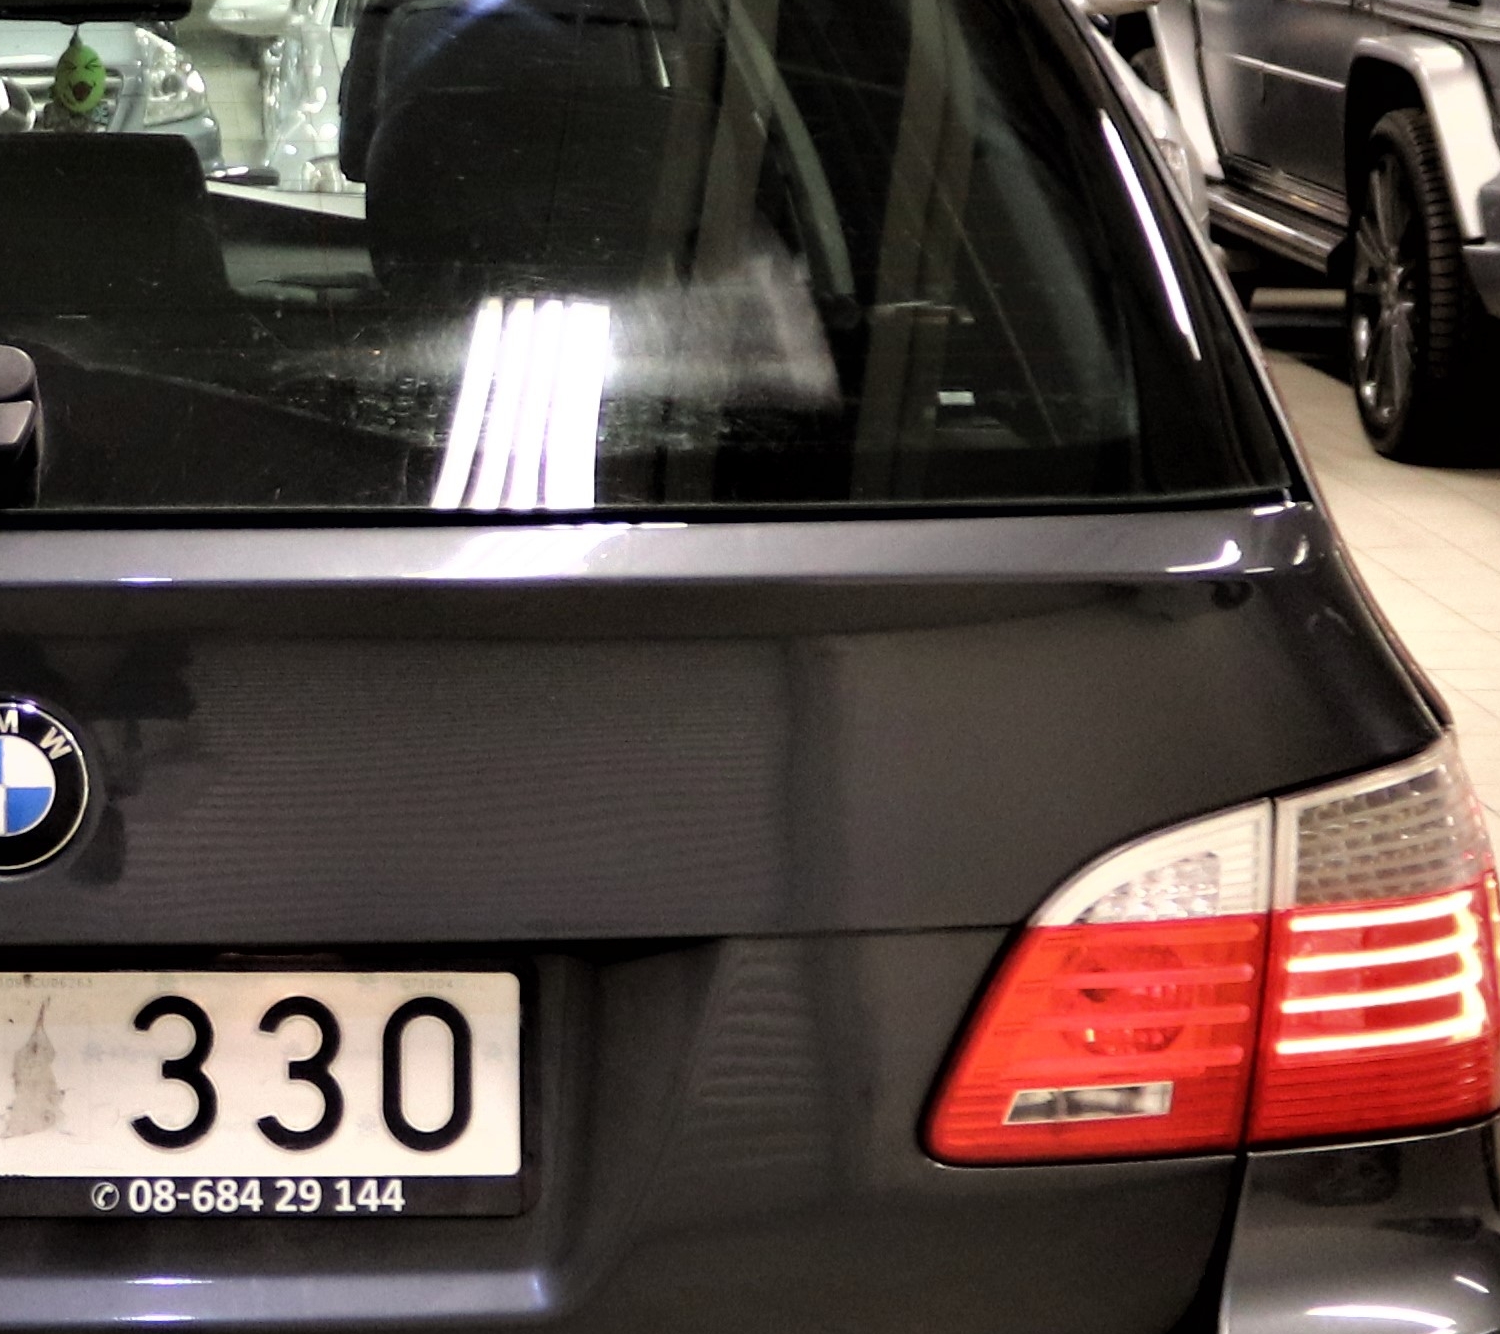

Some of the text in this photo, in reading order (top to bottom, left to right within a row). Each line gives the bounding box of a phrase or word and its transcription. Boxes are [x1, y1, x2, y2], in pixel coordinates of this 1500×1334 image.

[129, 994, 473, 1153] 330
[127, 1178, 407, 1214] 08-684 29 144
